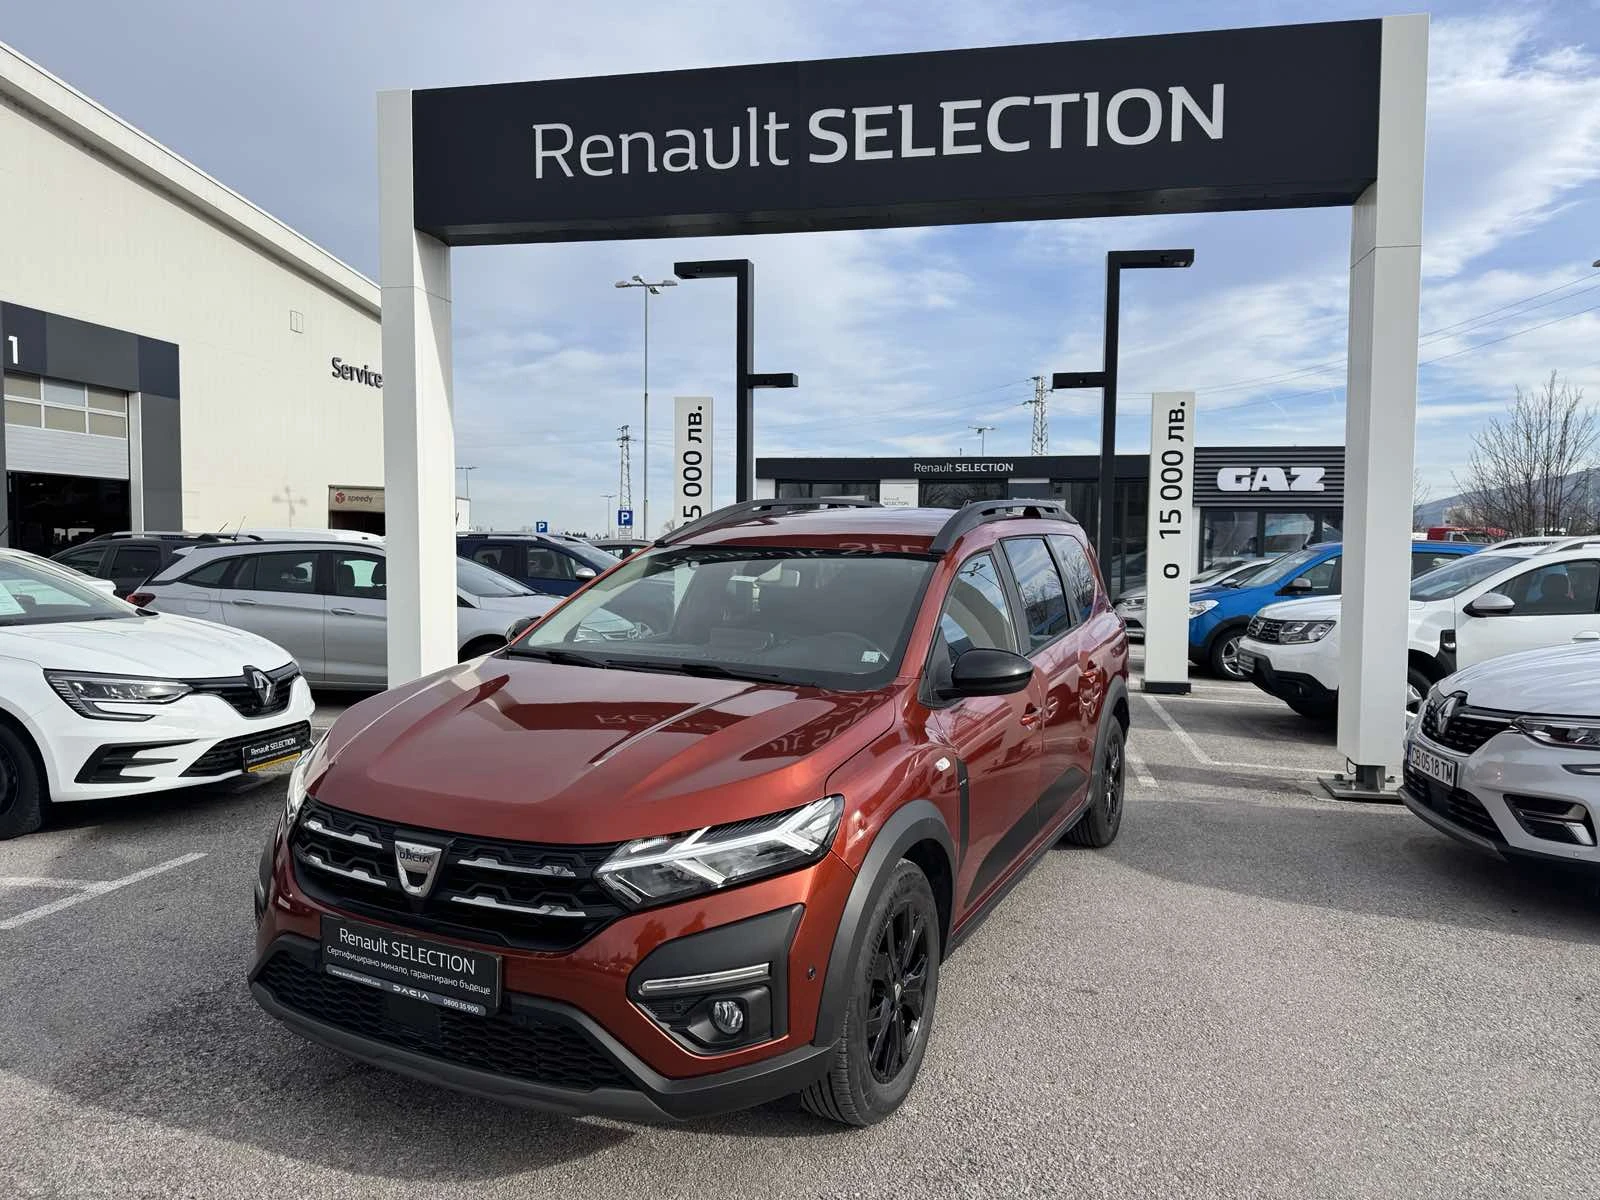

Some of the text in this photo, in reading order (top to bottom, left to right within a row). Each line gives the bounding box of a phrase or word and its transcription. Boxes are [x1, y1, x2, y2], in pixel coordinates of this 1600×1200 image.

[532, 83, 1225, 179] Renault SELECTION
[8, 335, 19, 365] 1
[332, 356, 384, 389] Service
[688, 405, 702, 444] лв.
[1168, 401, 1186, 442] лв.
[683, 450, 702, 497] 000
[913, 462, 1014, 473] Renault SELECTION
[1160, 450, 1184, 501] 000
[1217, 467, 1326, 492] GAZ
[621, 511, 630, 524] P
[1159, 509, 1182, 540] 15
[326, 945, 380, 967] Сертифицирано
[410, 968, 458, 987] гарантирано
[459, 979, 491, 995] бъдеще
[339, 927, 475, 976] Renault SELECTION
